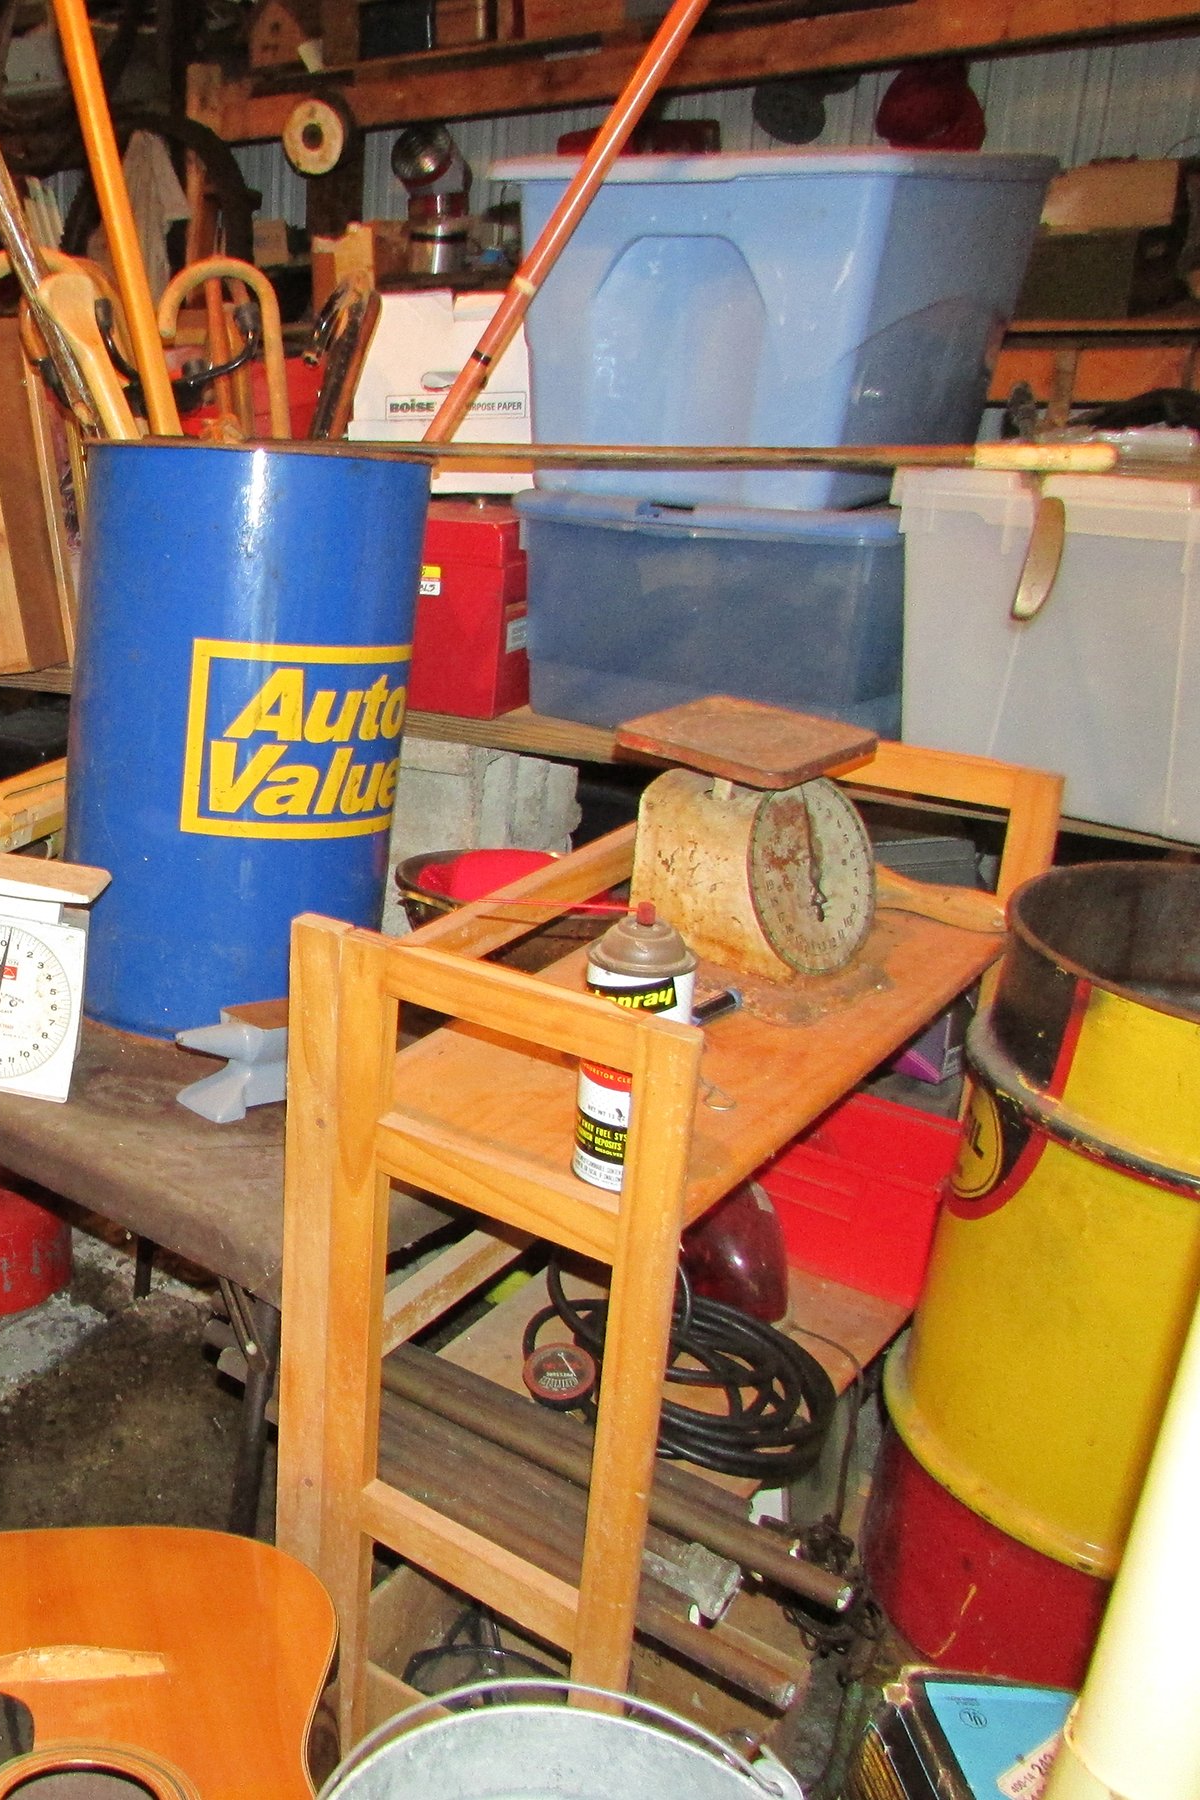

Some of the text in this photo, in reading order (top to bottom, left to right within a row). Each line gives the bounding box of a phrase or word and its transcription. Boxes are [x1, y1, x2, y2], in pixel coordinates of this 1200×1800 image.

[497, 401, 522, 411] PAPER
[222, 667, 407, 744] Auto
[208, 740, 401, 816] Value
[26, 951, 34, 959] 2
[37, 961, 45, 970] 3
[45, 973, 52, 981] 4
[49, 988, 57, 996] 5
[50, 1003, 58, 1012] 6
[48, 1018, 56, 1026] 7
[41, 1031, 49, 1040] 8
[32, 1043, 39, 1051] 9
[19, 1050, 30, 1058] 10
[8, 1056, 15, 1064] 11
[617, 1076, 632, 1084] CLE
[595, 1127, 611, 1139] FUEL
[614, 1132, 627, 1142] SYS
[594, 1136, 622, 1151] DEPOSITS
